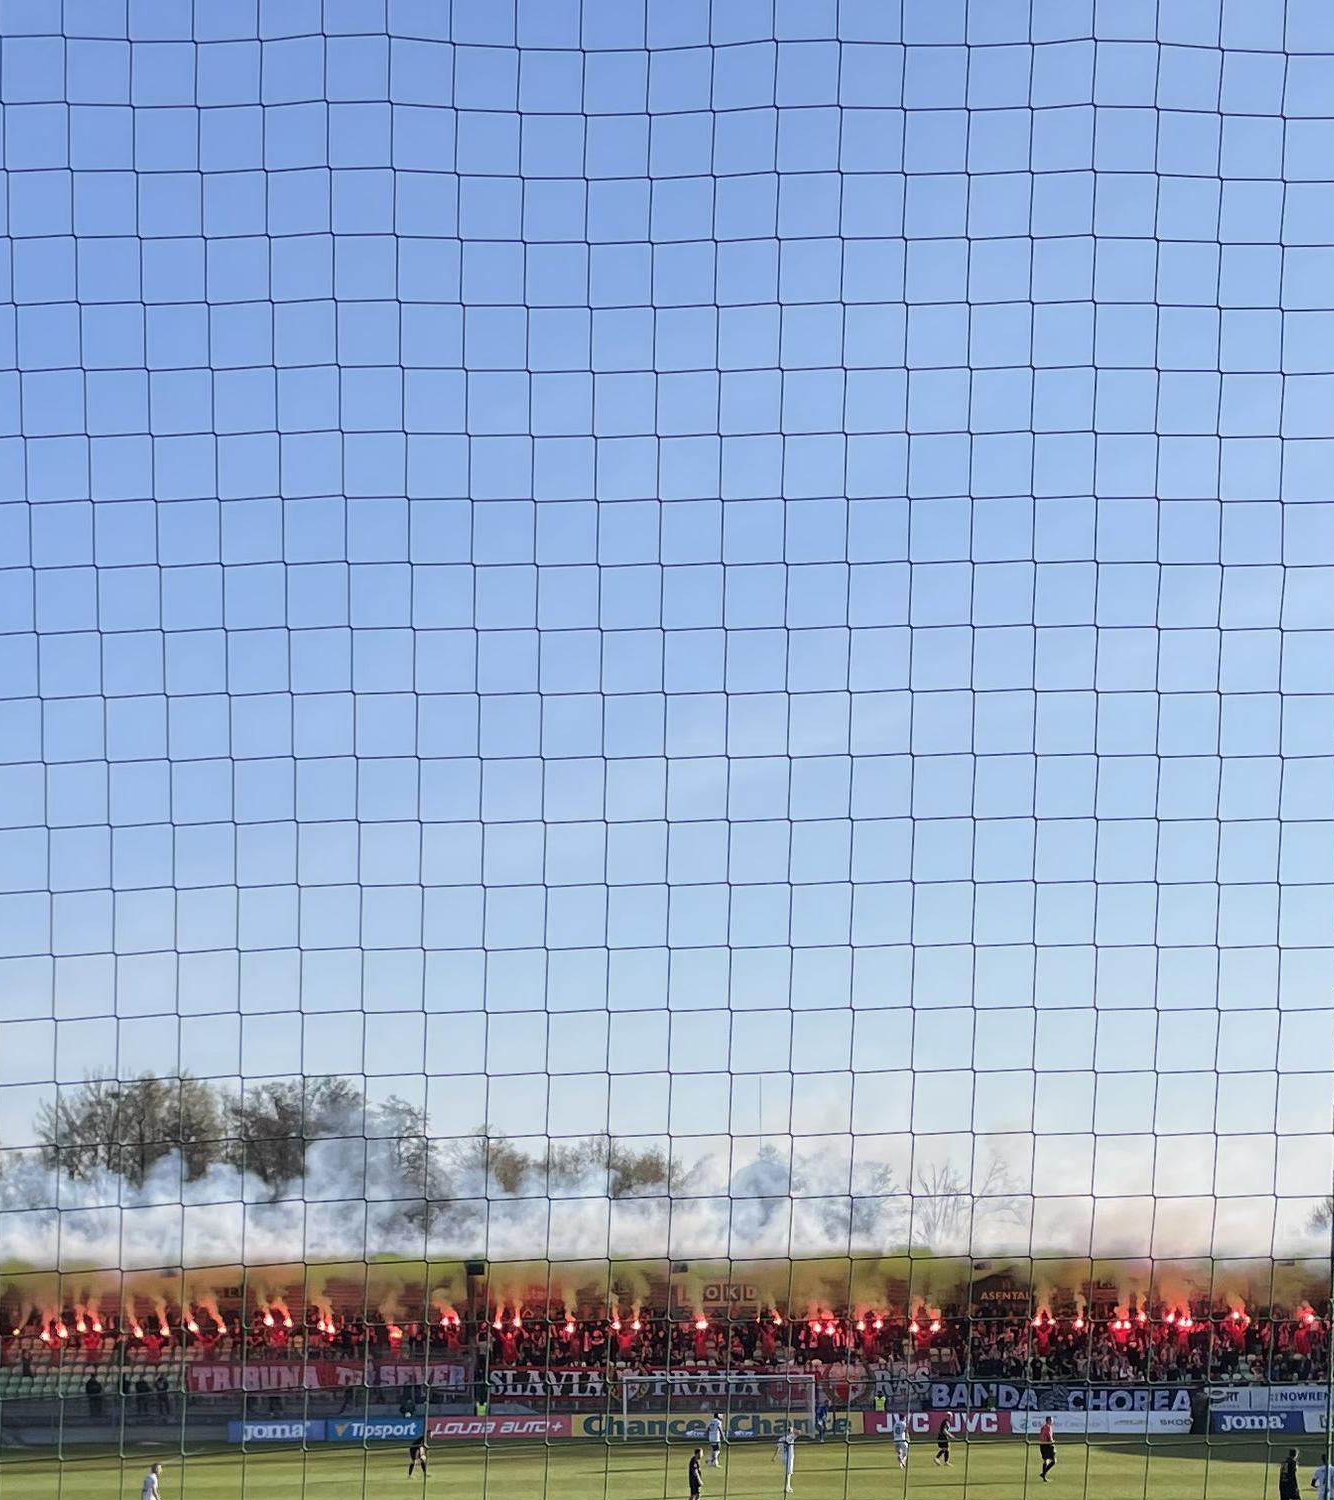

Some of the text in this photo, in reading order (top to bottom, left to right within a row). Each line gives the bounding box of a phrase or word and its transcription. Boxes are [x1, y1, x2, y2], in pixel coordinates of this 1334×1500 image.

[980, 1290, 1030, 1300] ASENTAL
[192, 1365, 318, 1391] TRIBUNA
[380, 1364, 467, 1389] SEVER
[488, 1369, 607, 1397] SLAVIA
[651, 1369, 762, 1397] PRAHA
[931, 1383, 1039, 1409] BANDA
[1067, 1389, 1192, 1412] CHOREA
[350, 1420, 416, 1438] Tipsport
[582, 1414, 707, 1438] Chance
